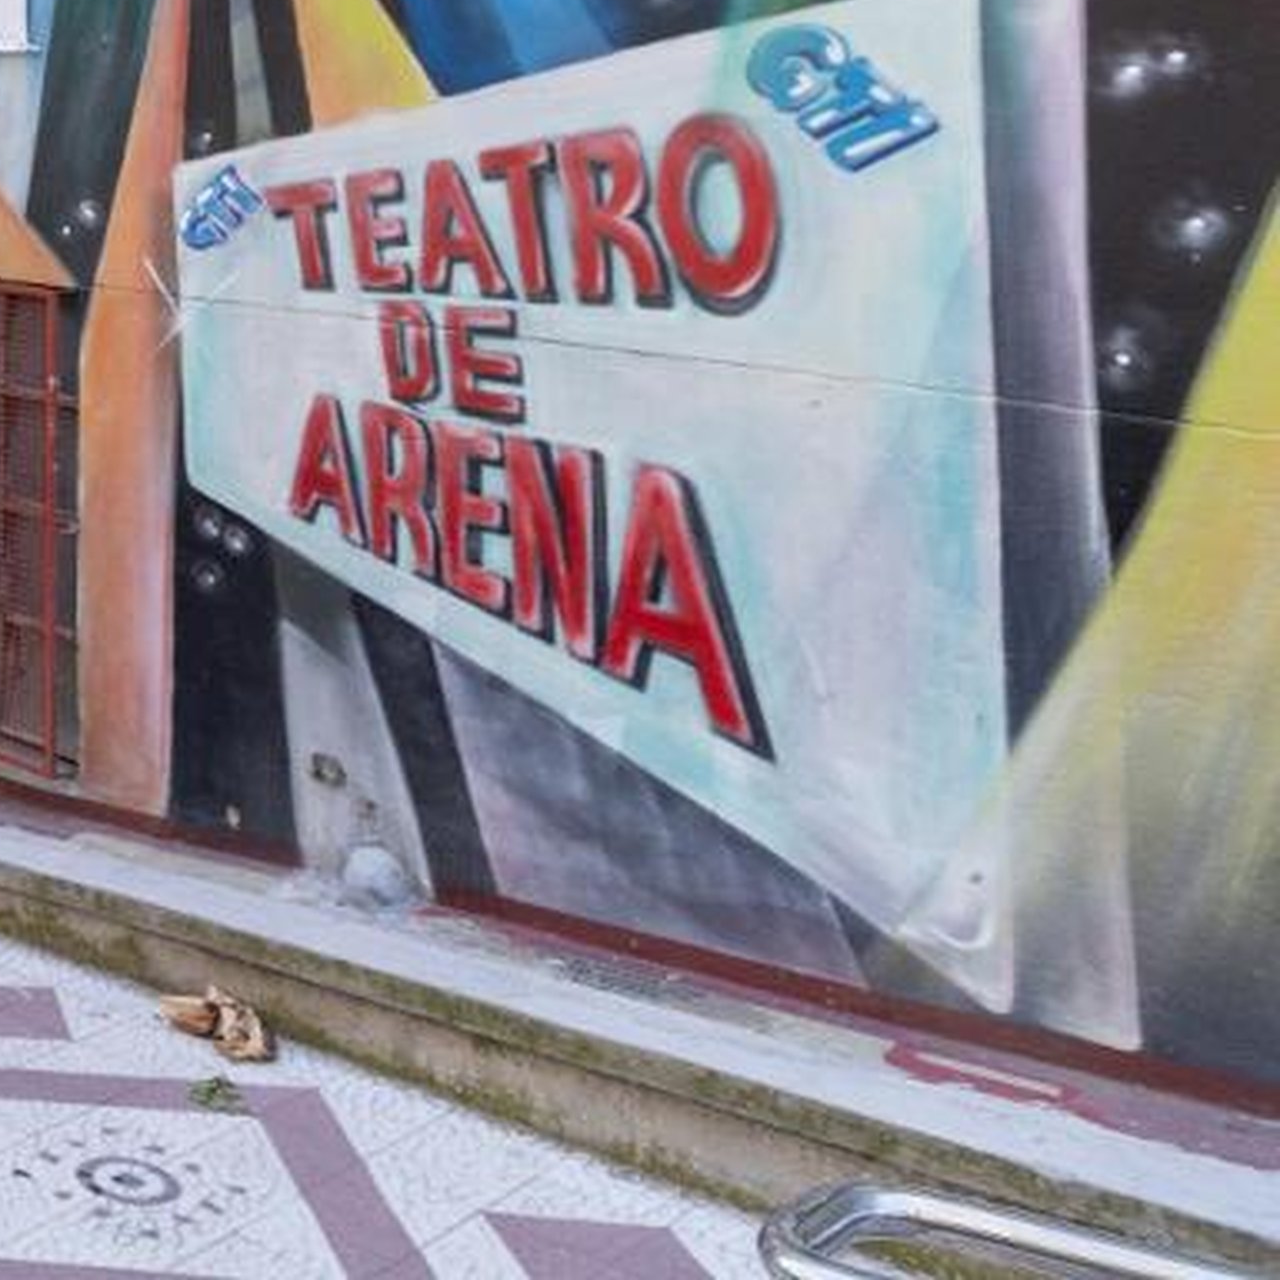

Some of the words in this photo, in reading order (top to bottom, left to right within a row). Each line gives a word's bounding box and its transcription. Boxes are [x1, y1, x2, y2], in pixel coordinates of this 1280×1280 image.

[266, 111, 782, 317] TEATRO
[373, 298, 528, 424] DE
[289, 392, 778, 766] ARENA
